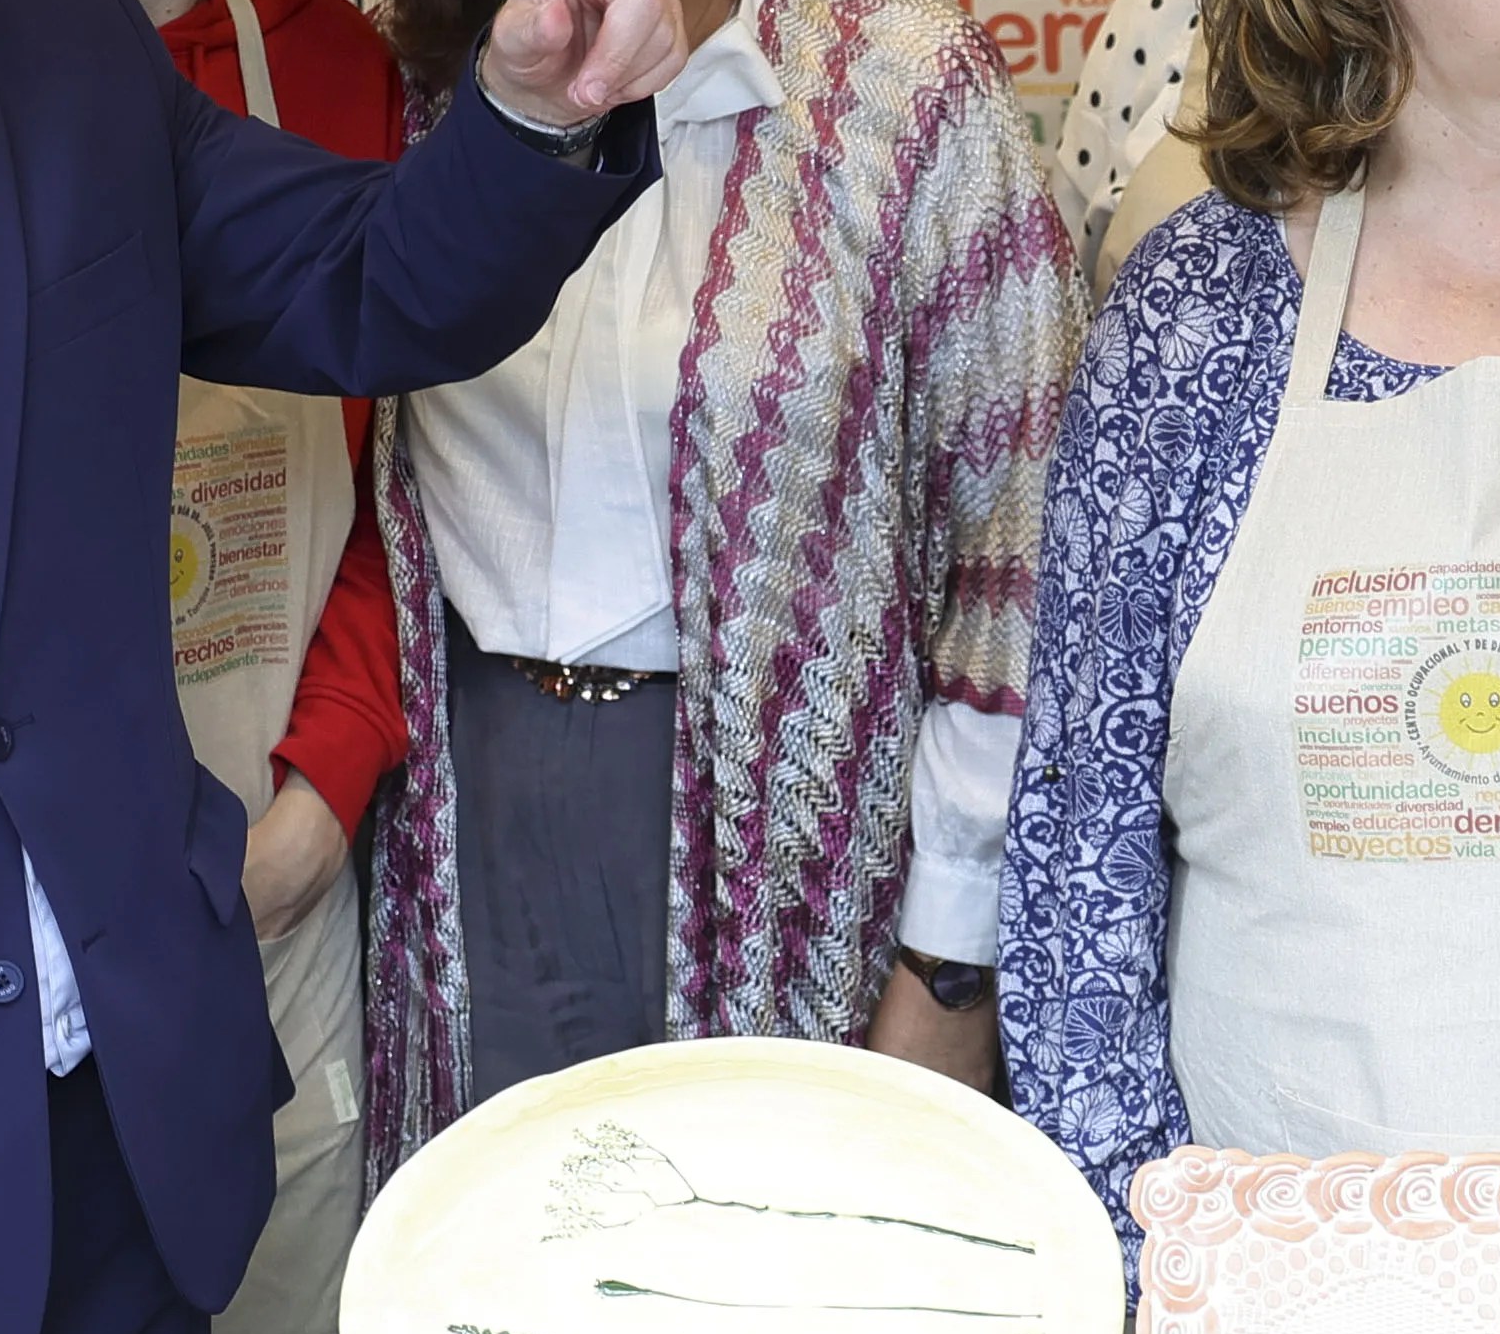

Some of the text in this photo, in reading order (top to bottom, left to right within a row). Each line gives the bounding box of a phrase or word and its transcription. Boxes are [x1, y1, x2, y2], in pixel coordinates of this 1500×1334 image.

[191, 466, 287, 504] diversidad
[218, 541, 286, 566] bienestar
[1311, 566, 1427, 598] inclusión
[1367, 590, 1470, 623] empleo
[1302, 618, 1383, 635] entornos
[1436, 617, 1500, 634] metas
[175, 634, 235, 667] rechos
[1297, 635, 1419, 664] personas
[1463, 639, 1471, 651] Y
[1474, 638, 1488, 651] DE
[1300, 663, 1402, 681] diferencias
[1407, 642, 1461, 697] OCUPACIONAL
[1294, 687, 1399, 714] sueños
[1343, 715, 1399, 728] proyectos
[1404, 700, 1421, 742] CENTRO
[1299, 726, 1401, 745] inclusión
[1298, 750, 1415, 770] capacidades
[1418, 744, 1489, 786] Ayuntamiento
[1303, 778, 1460, 801] oportunidades
[1395, 799, 1464, 814] diversidad
[1309, 818, 1351, 834] empleo
[1352, 812, 1452, 831] educación
[1310, 830, 1451, 861] proyectos
[1453, 840, 1495, 858] vida
